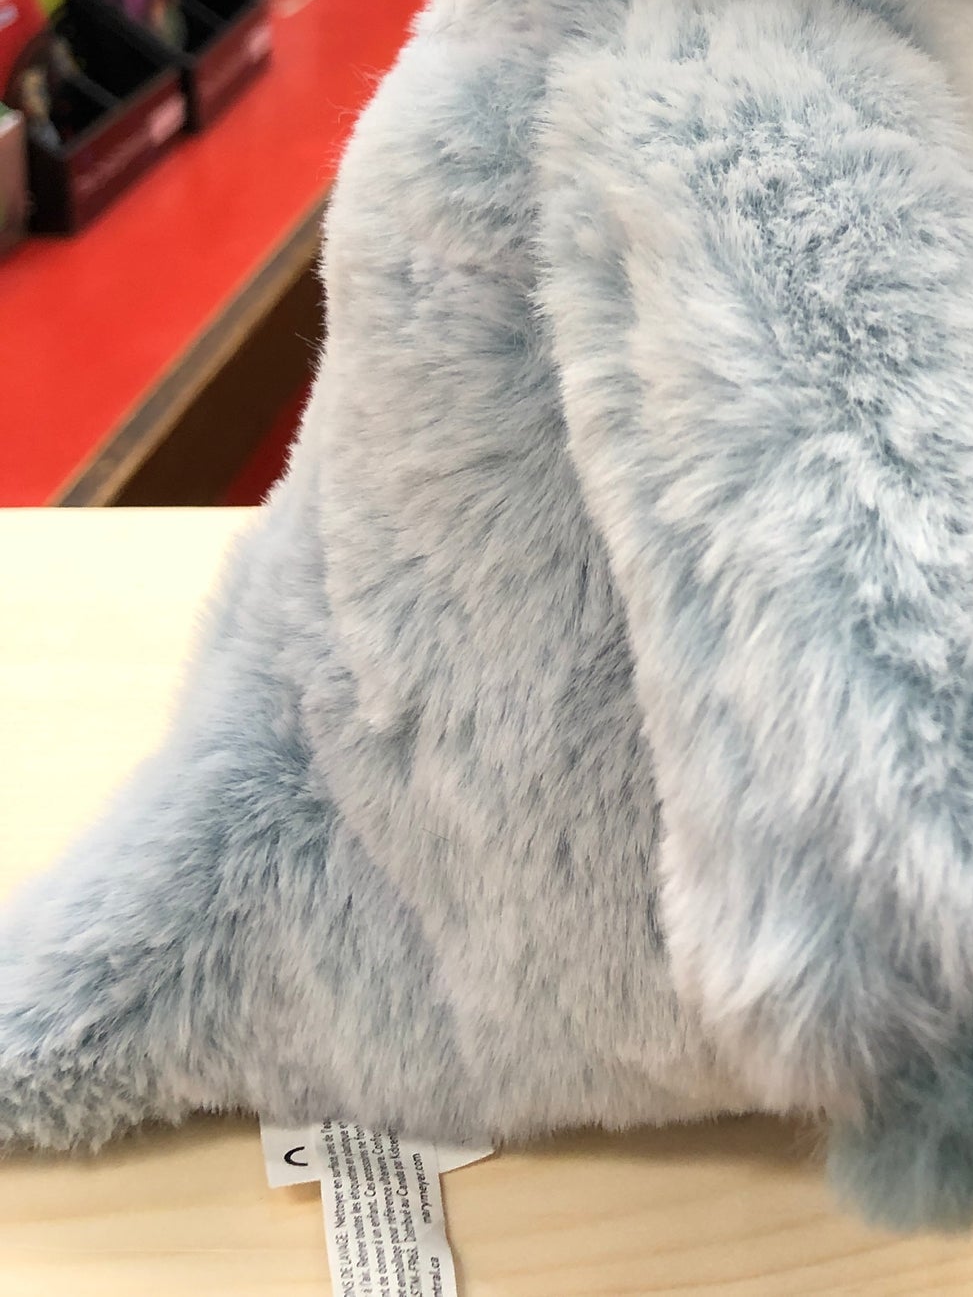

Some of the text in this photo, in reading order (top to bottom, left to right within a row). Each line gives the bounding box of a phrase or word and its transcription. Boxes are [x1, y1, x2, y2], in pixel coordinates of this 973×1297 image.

[321, 1134, 333, 1142] de
[357, 1140, 367, 1149] ne
[364, 1182, 376, 1197] Ces
[411, 1152, 433, 1224] marymeyer.com
[334, 1190, 347, 1228] Nettoyer
[348, 1201, 362, 1214] les
[400, 1197, 409, 1208] au
[352, 1215, 365, 1239] toutes
